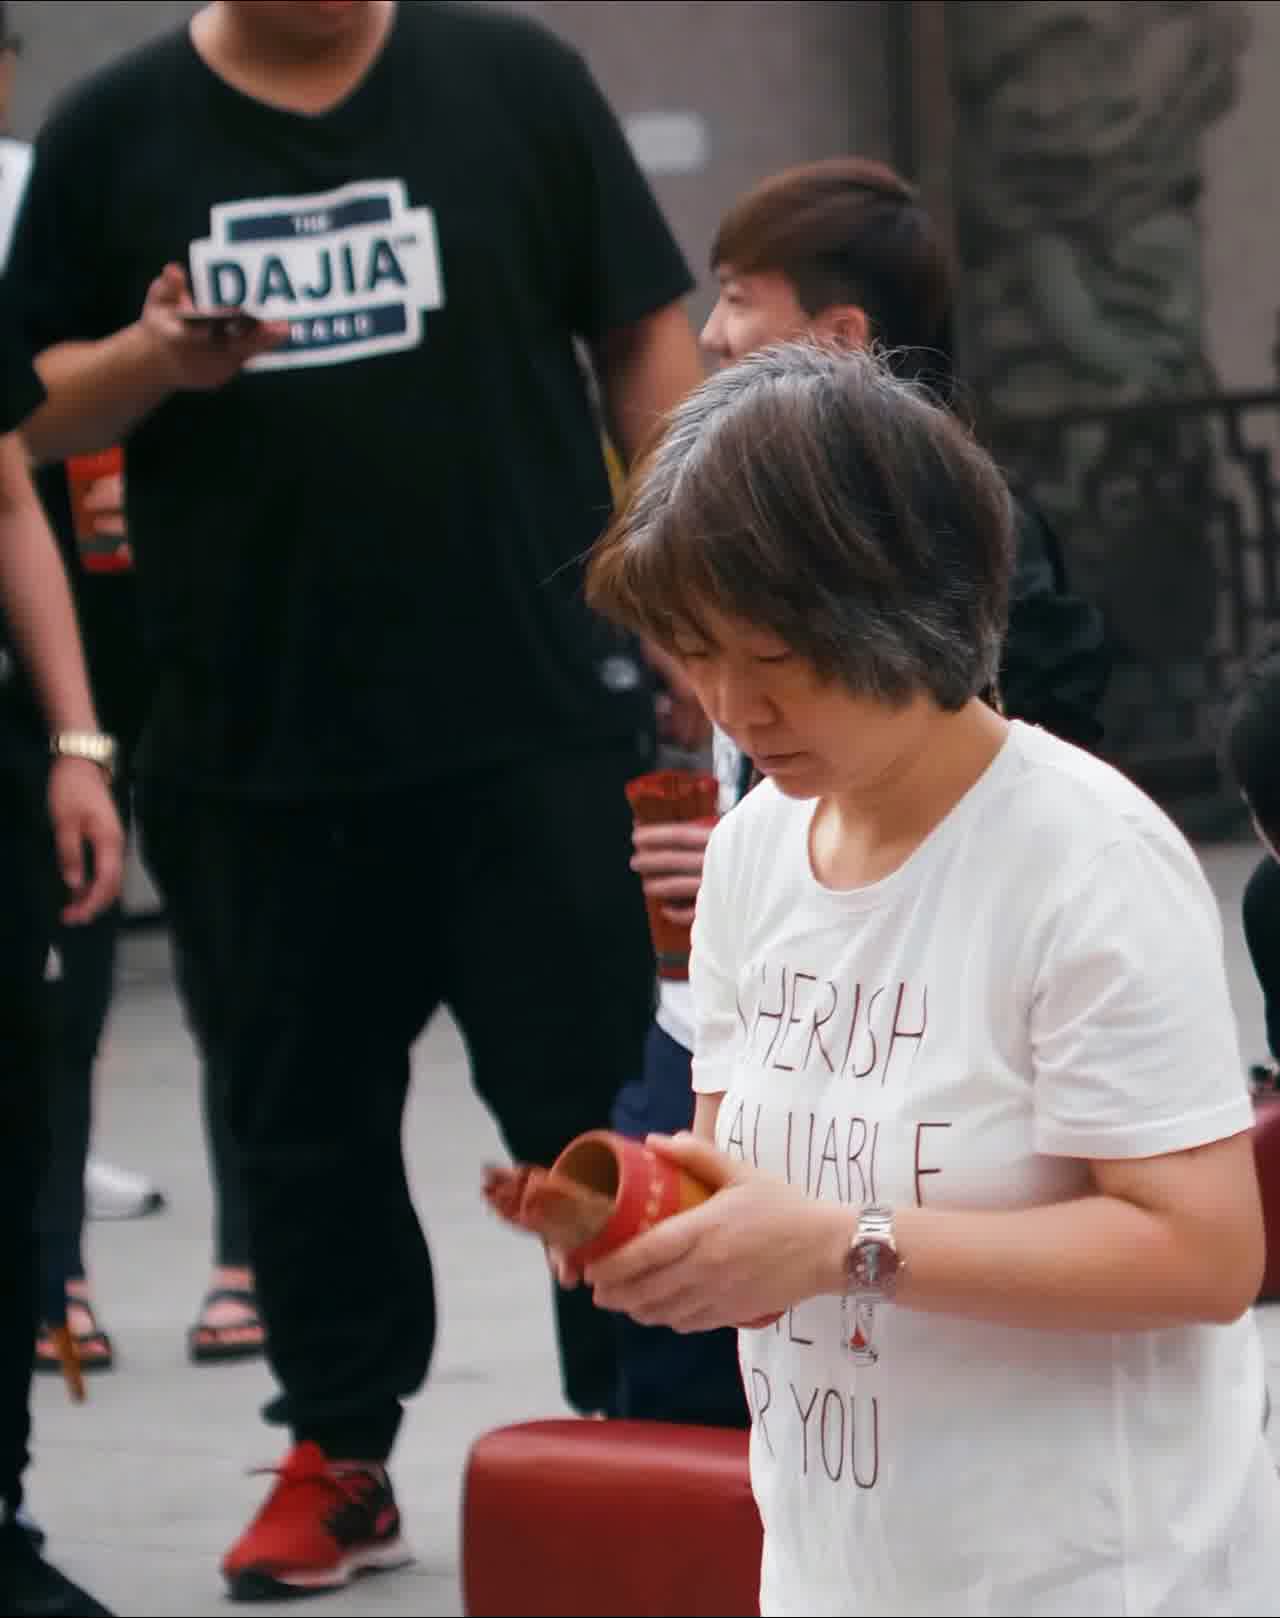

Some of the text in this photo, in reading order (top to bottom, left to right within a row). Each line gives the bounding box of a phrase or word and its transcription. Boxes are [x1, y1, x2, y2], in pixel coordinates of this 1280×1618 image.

[208, 238, 407, 307] DAJIA
[290, 314, 374, 343] RAND
[789, 1383, 879, 1488] YOU
